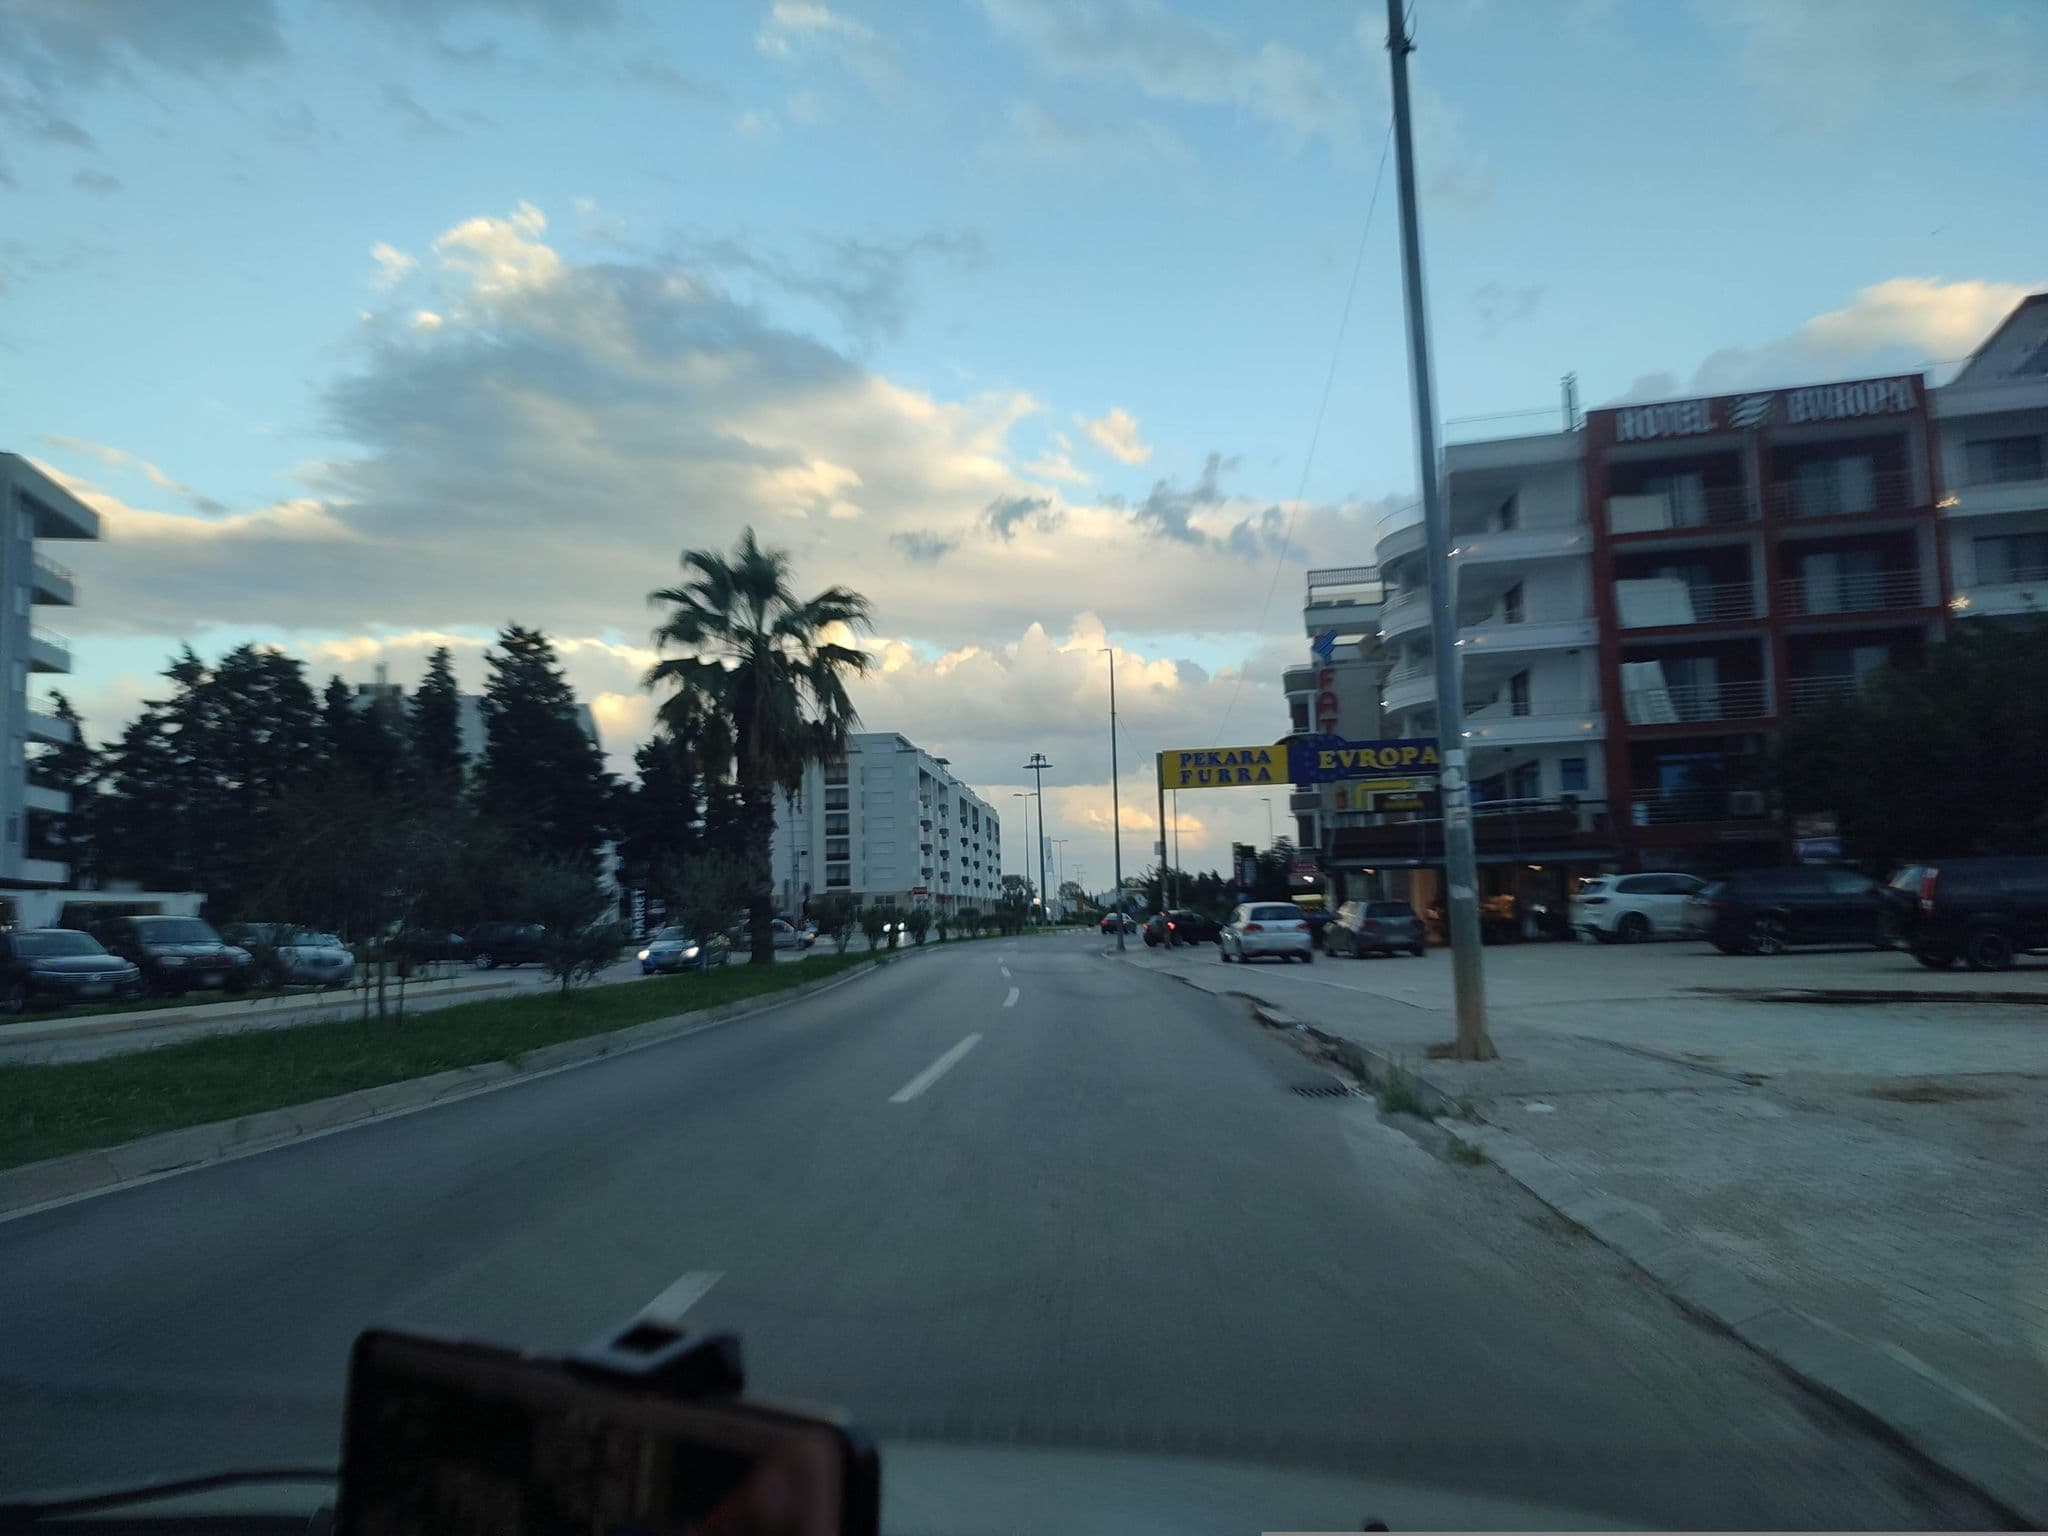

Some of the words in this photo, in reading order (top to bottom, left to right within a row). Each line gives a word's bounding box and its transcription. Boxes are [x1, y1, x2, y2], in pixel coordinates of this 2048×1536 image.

[1616, 400, 1718, 441] HOTEL
[1180, 750, 1271, 767] PEKARA
[1318, 745, 1441, 770] EVROPA
[1180, 767, 1272, 785] FURRA
[631, 890, 646, 938] MARKET
